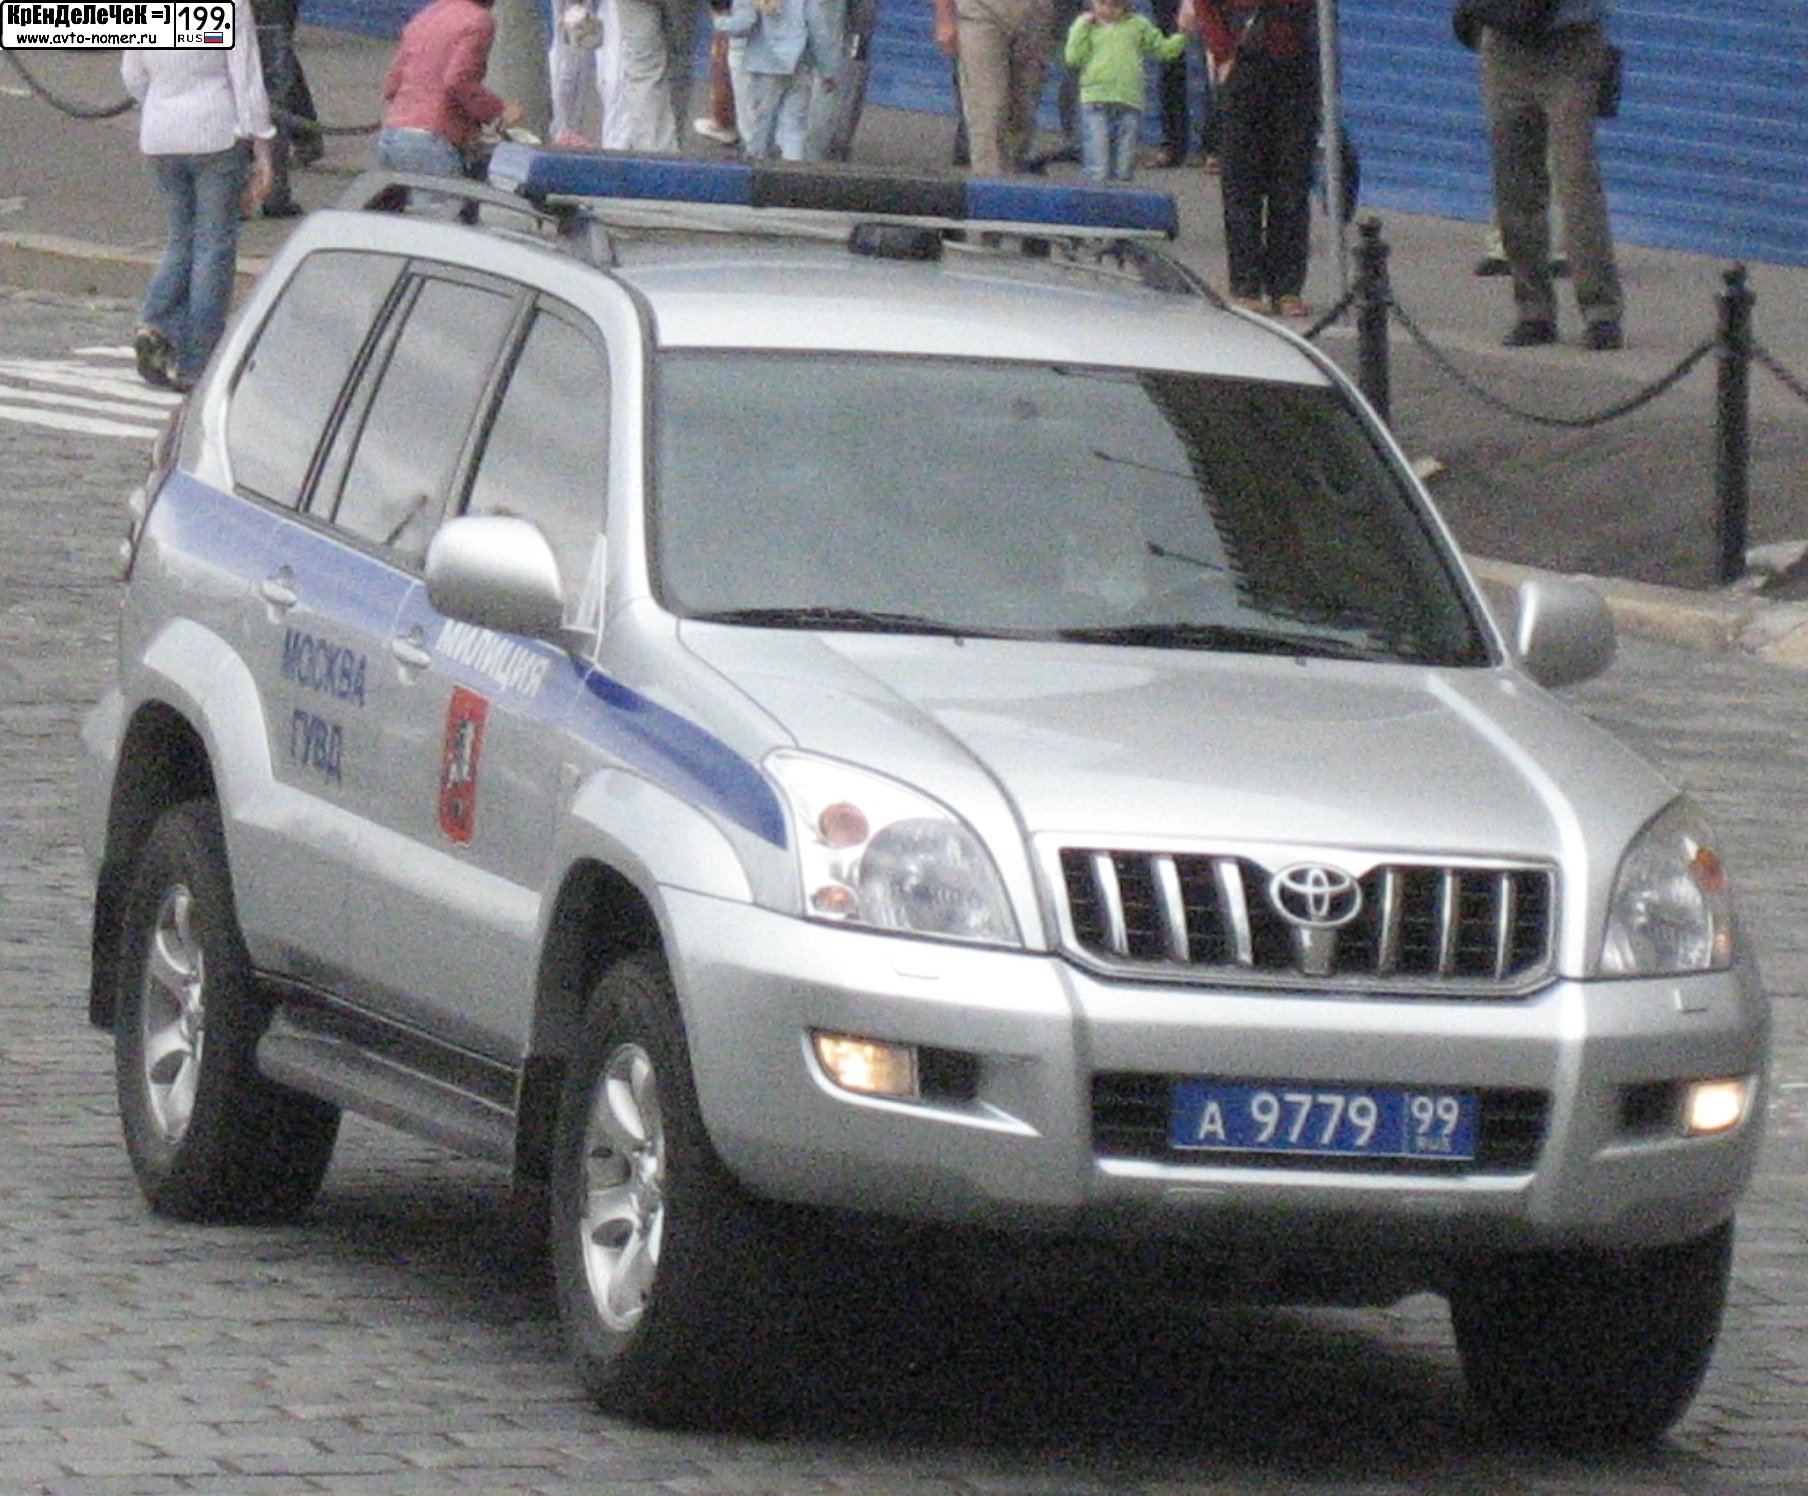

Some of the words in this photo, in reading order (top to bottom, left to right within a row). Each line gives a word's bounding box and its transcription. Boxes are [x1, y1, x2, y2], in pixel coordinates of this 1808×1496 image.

[282, 629, 367, 706] МОСКВА
[437, 619, 549, 697] МИЛИЦИЯ
[290, 708, 342, 787] ГУВД
[1251, 1091, 1379, 1147] 9779
[1410, 1096, 1460, 1134] 99
